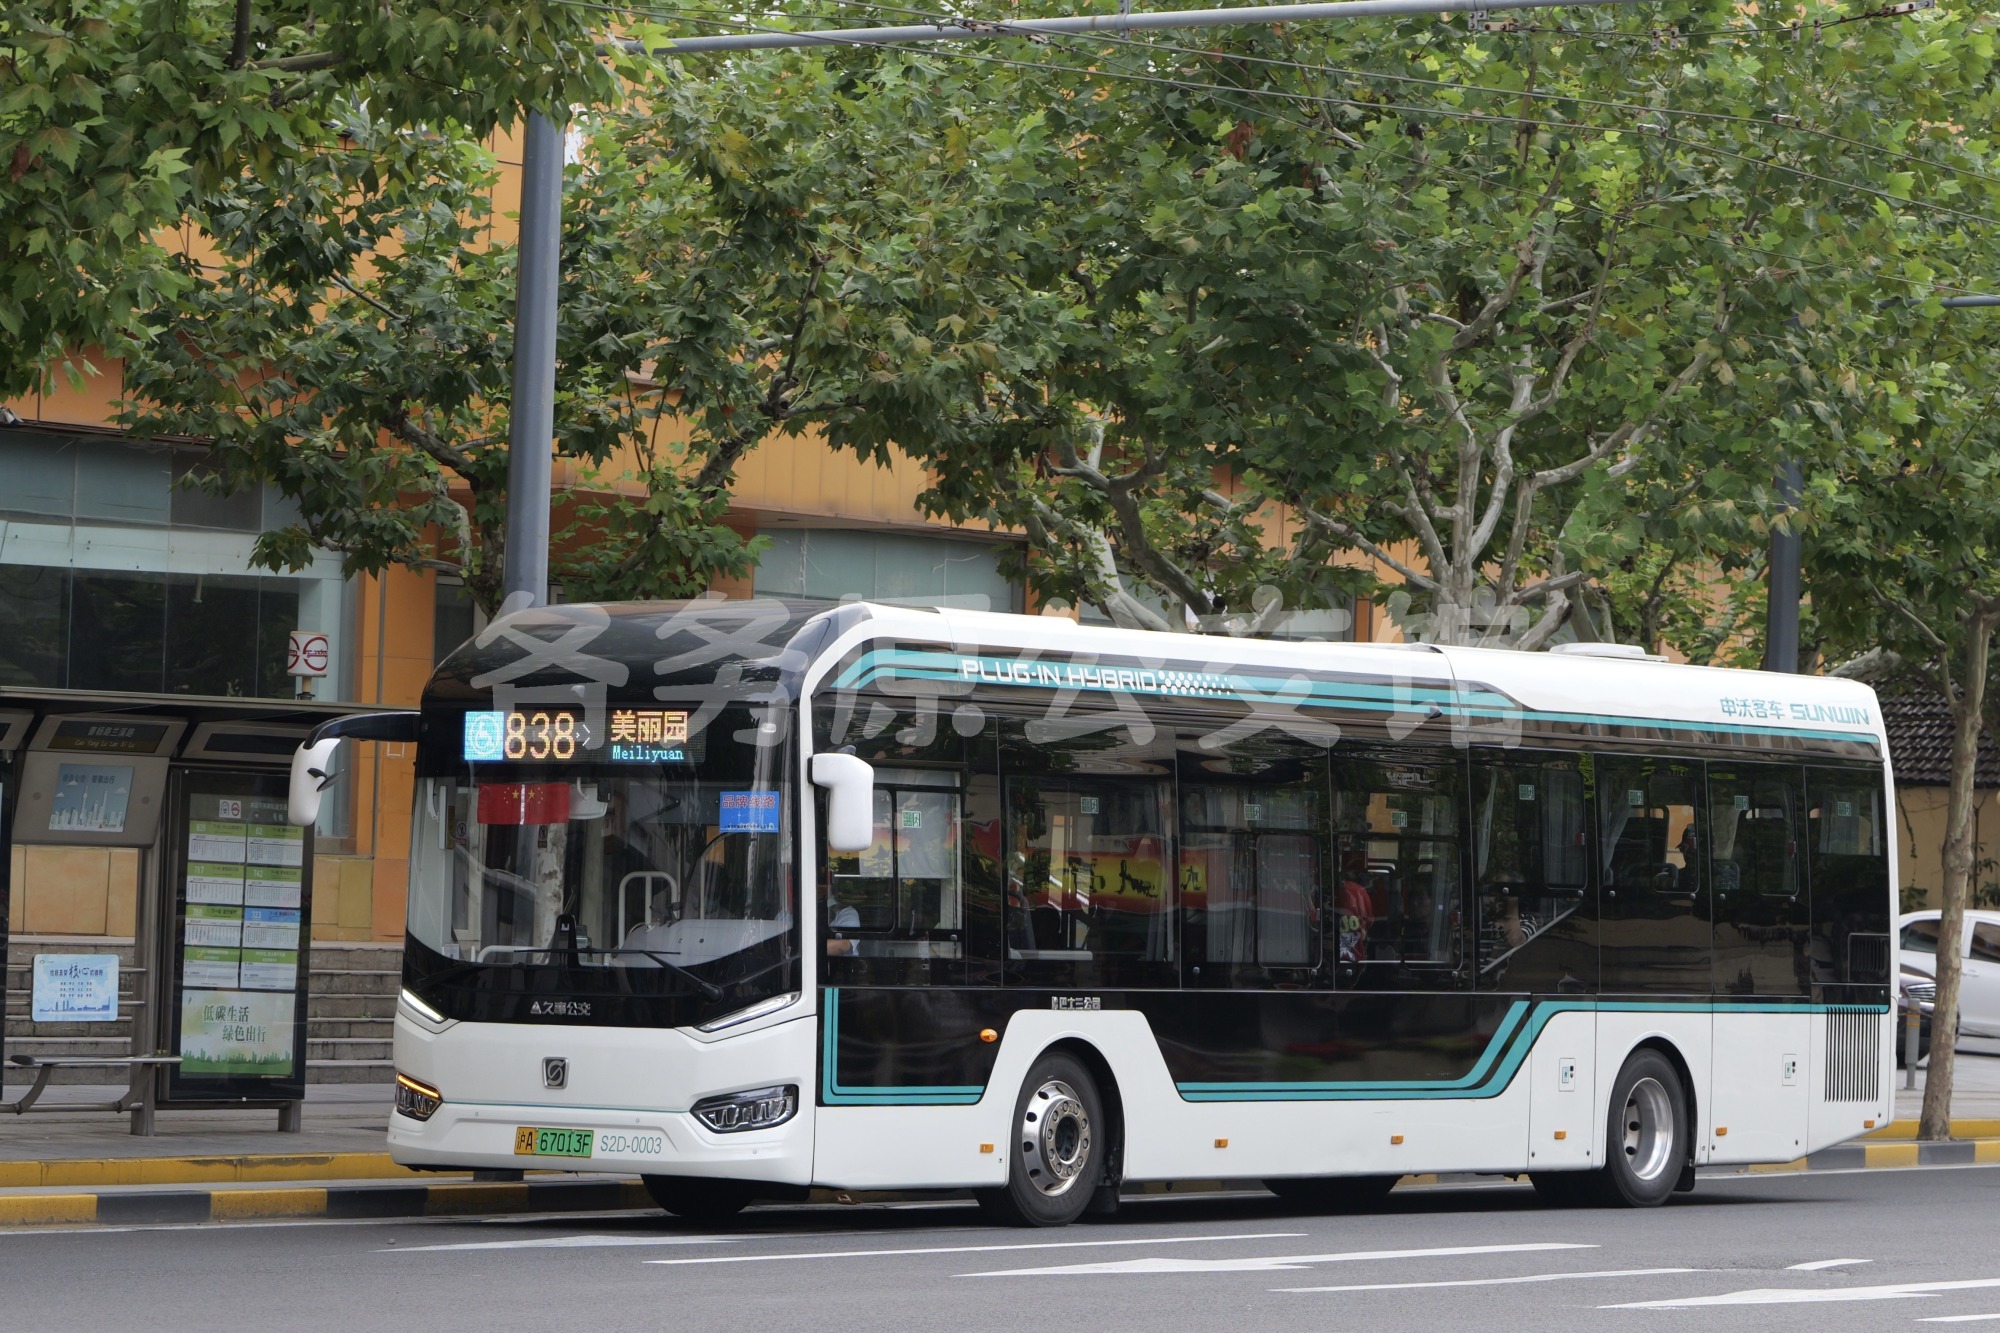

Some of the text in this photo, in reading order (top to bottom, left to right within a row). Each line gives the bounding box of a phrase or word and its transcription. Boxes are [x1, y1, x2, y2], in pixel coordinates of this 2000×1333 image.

[961, 659, 1157, 691] PLUG-IN HYBRID
[1720, 697, 1870, 725] 申沃客车 SUNWIN
[504, 709, 689, 759] 838 美丽园
[612, 745, 685, 762] Meiliyuan
[722, 794, 776, 809] 品牌线路
[203, 1005, 249, 1022] 低碳生活
[541, 1001, 591, 1016] 久事公交
[222, 1025, 266, 1042] 绿色出行
[600, 1135, 662, 1154] S2D-0003
